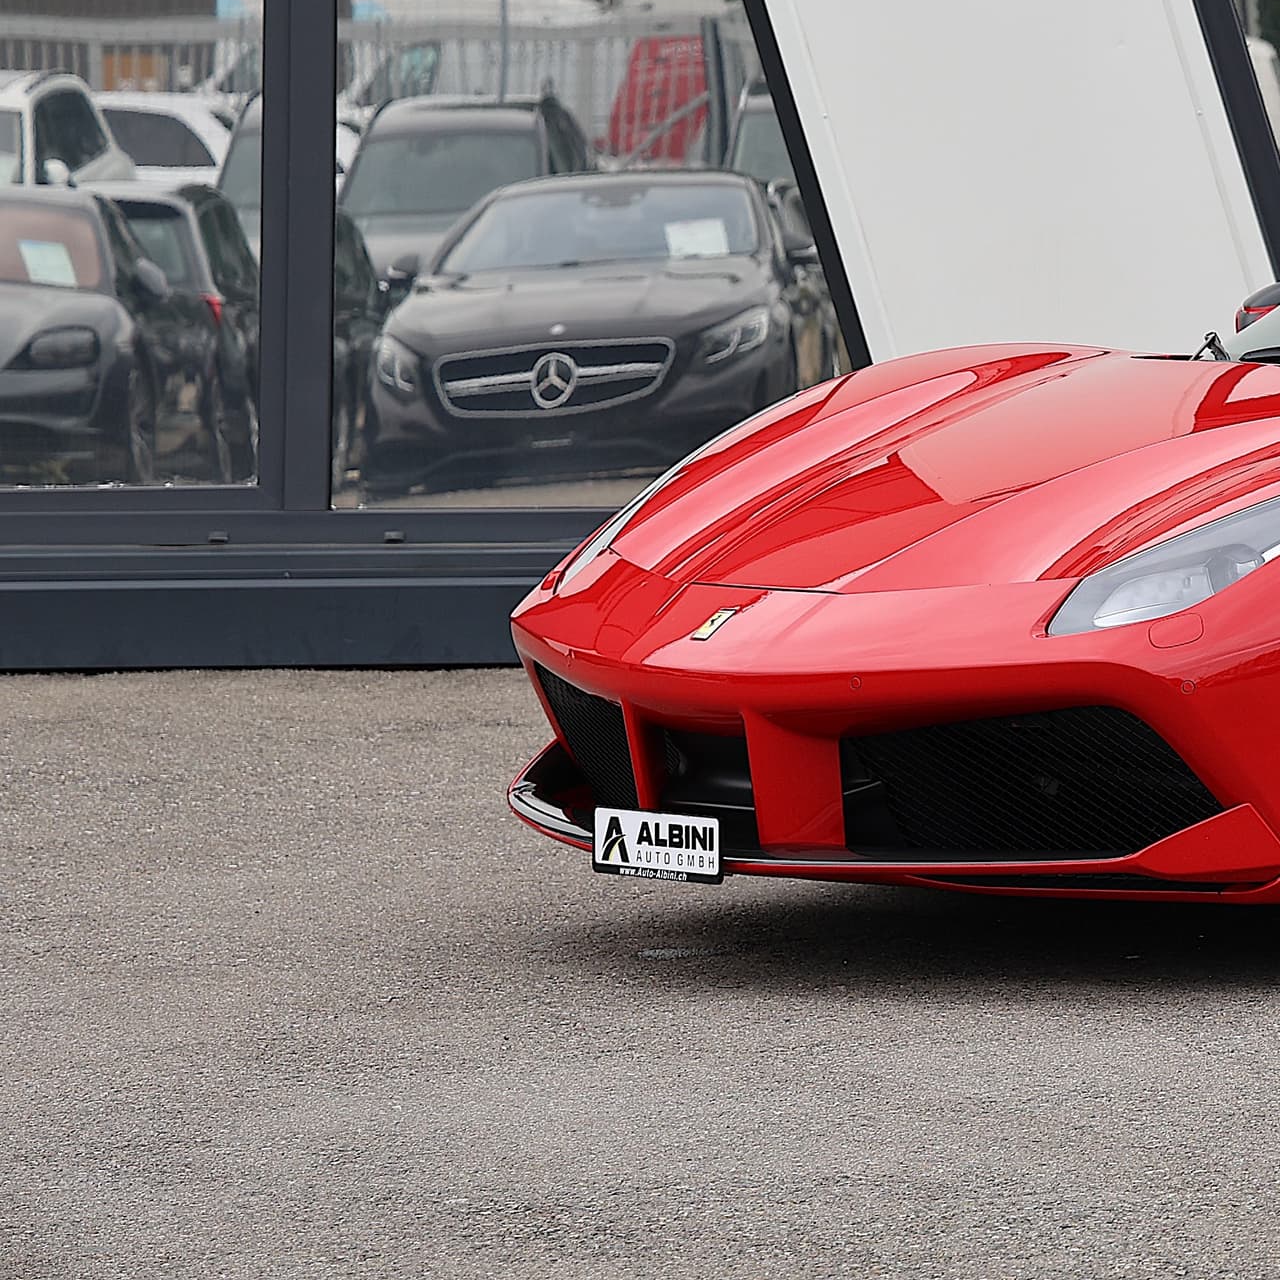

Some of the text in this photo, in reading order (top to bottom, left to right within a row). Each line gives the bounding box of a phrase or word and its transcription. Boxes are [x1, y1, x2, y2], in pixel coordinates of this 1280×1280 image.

[636, 821, 715, 852] ALBINI
[636, 850, 715, 870] AUTO GMBH
[619, 867, 688, 881] www.Auto-Albini.ch
